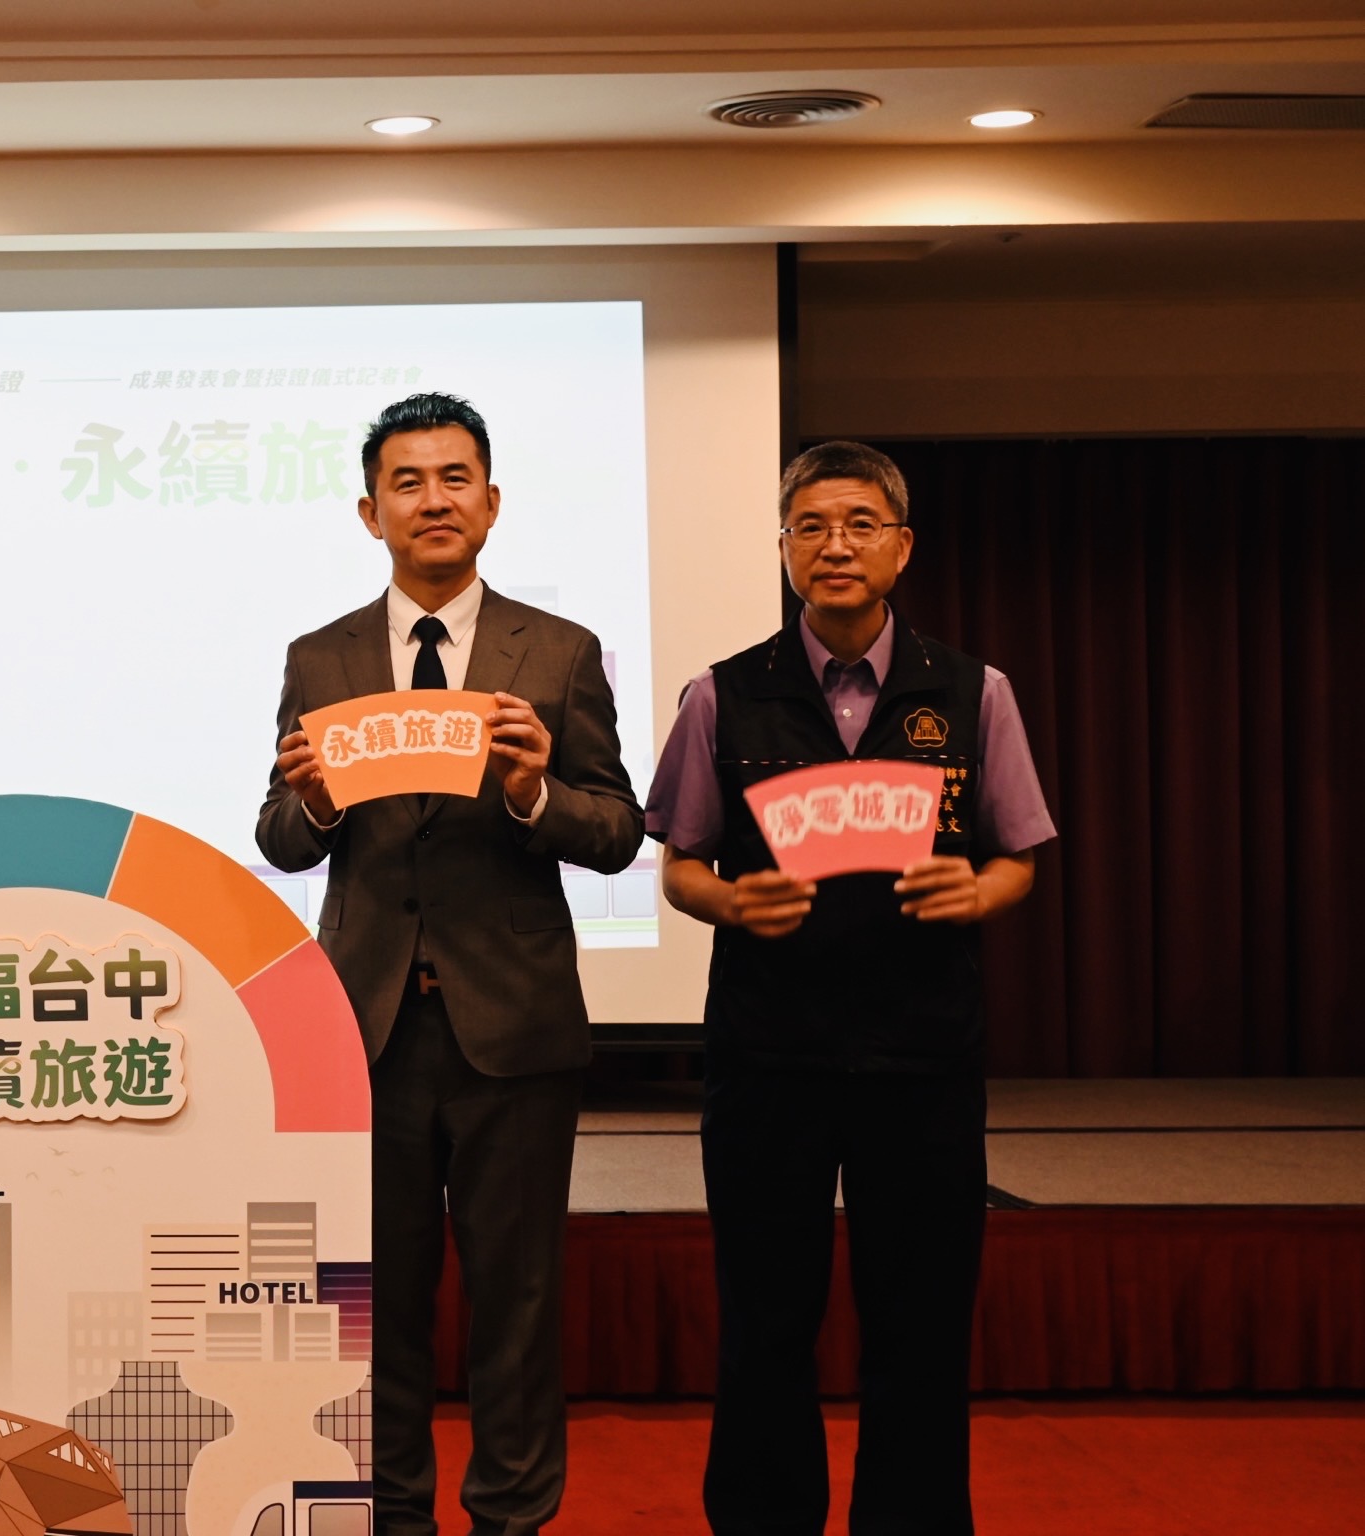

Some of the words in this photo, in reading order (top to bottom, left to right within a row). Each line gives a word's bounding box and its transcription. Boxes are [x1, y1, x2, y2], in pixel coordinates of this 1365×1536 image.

[59, 419, 369, 508] 永續旅
[327, 715, 477, 762] 永續旅遊
[219, 1282, 313, 1304] HOTEL
